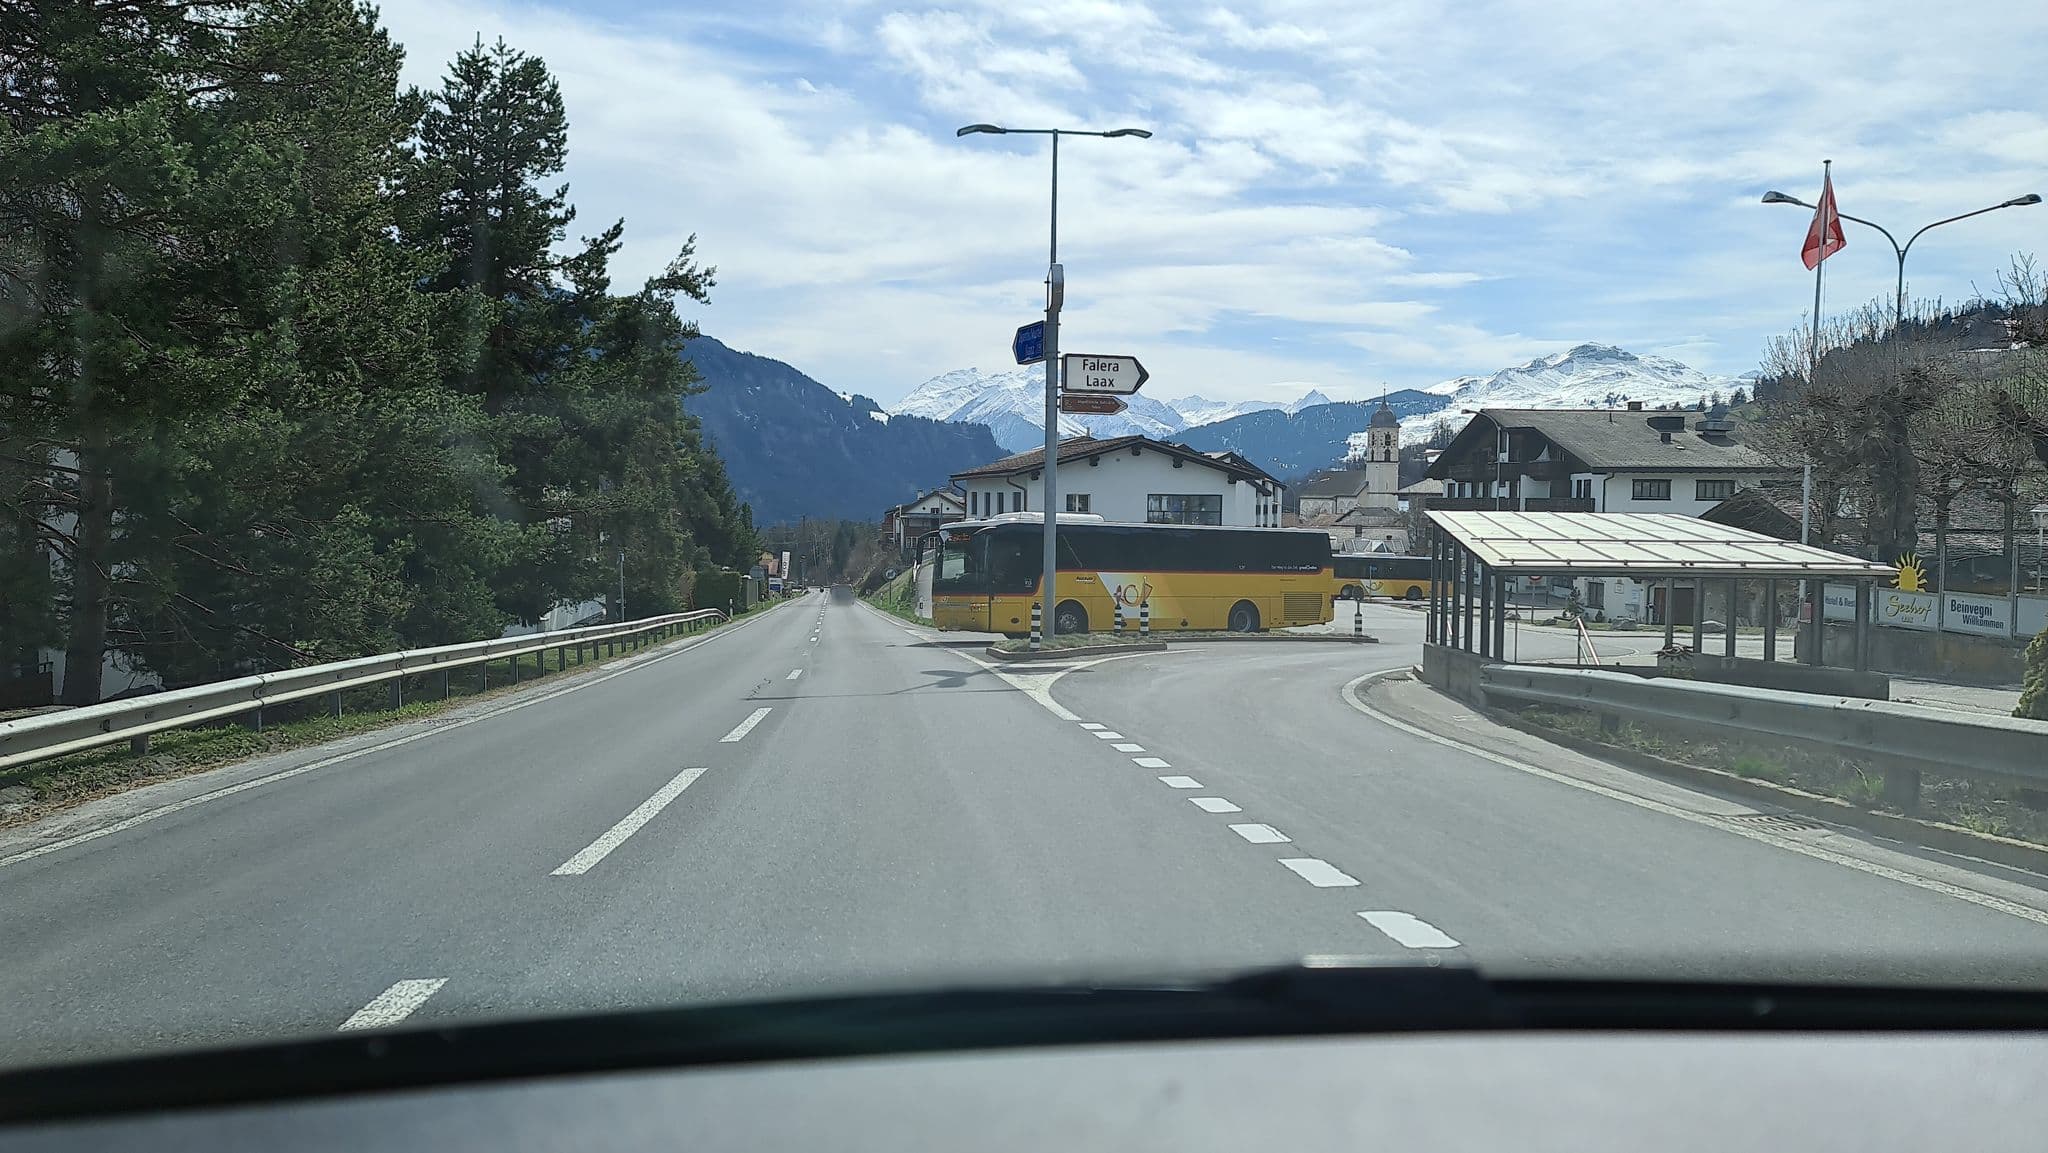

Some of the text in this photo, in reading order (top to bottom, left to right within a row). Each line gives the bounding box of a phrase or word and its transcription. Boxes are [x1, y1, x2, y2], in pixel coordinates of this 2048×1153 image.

[1082, 359, 1119, 372] Falera
[1086, 375, 1115, 387] Laax
[1885, 595, 1933, 622] Seehof
[1950, 599, 1992, 618] Beinvegni
[1962, 614, 2004, 629] Willkommen
